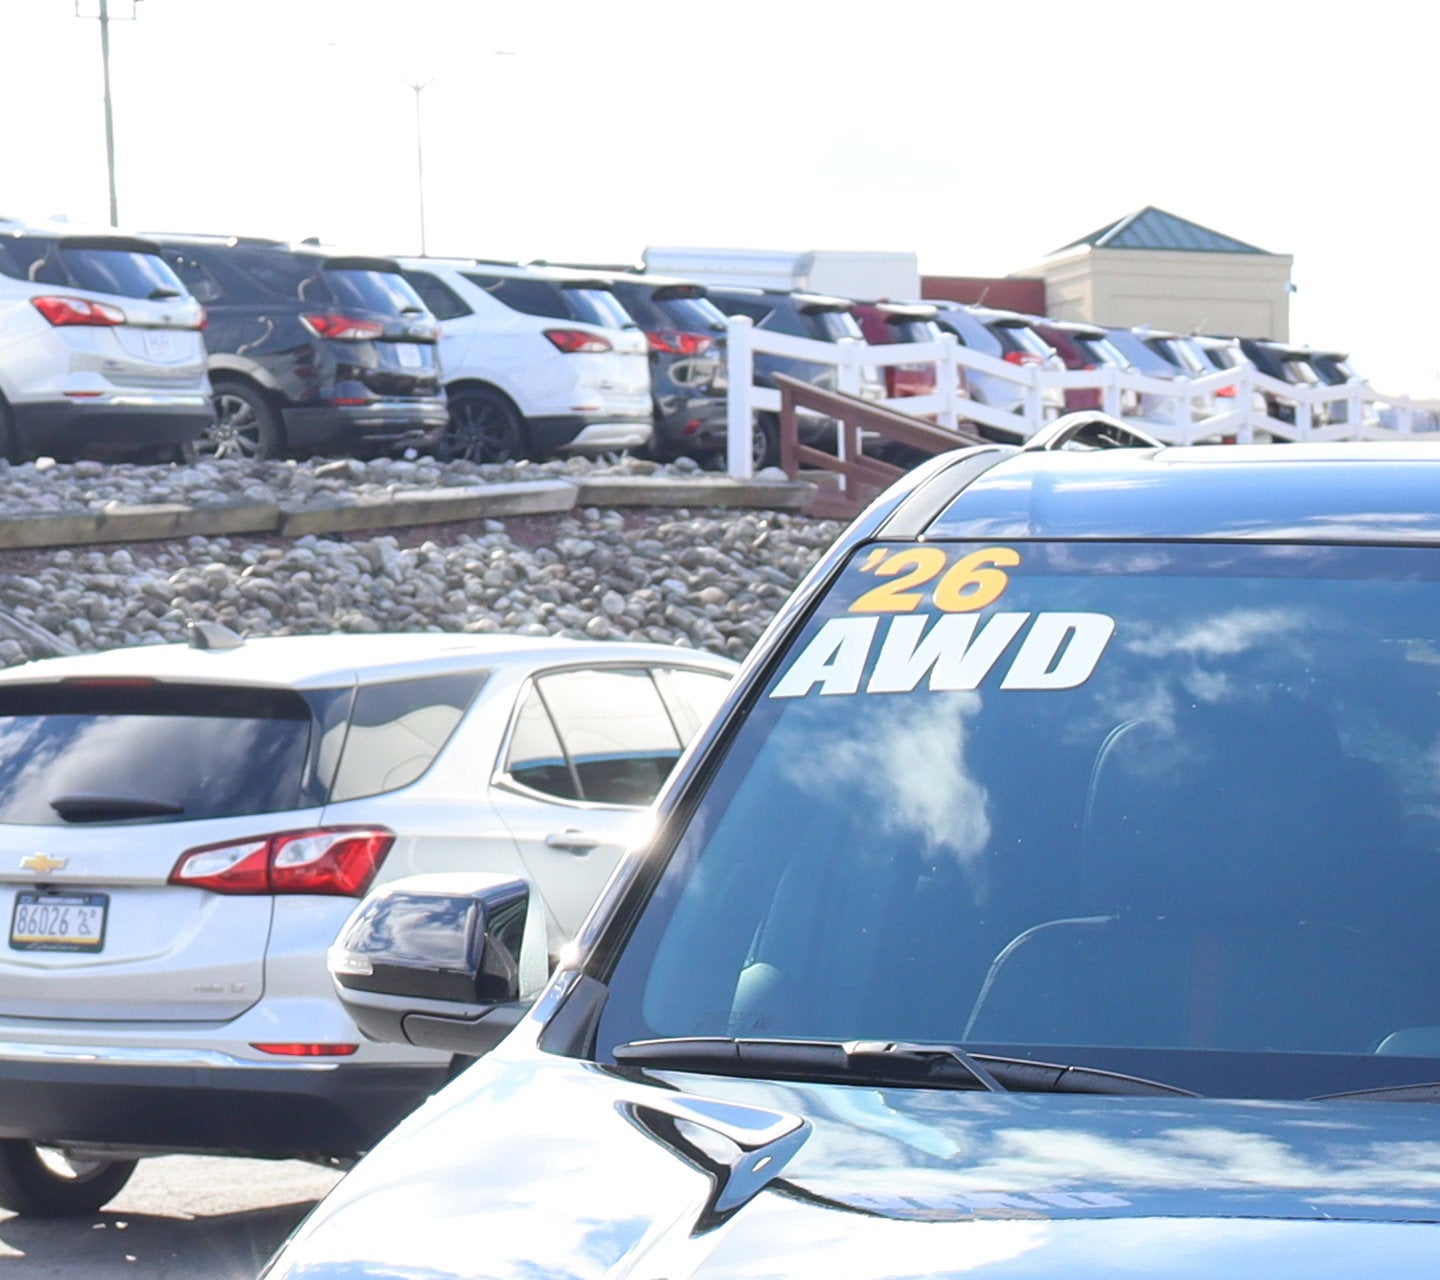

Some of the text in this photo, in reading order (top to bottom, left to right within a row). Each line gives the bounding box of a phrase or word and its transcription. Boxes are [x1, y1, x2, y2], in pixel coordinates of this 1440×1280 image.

[847, 547, 1021, 612] '26
[769, 612, 1116, 698] AWD
[17, 905, 70, 935] 86026
